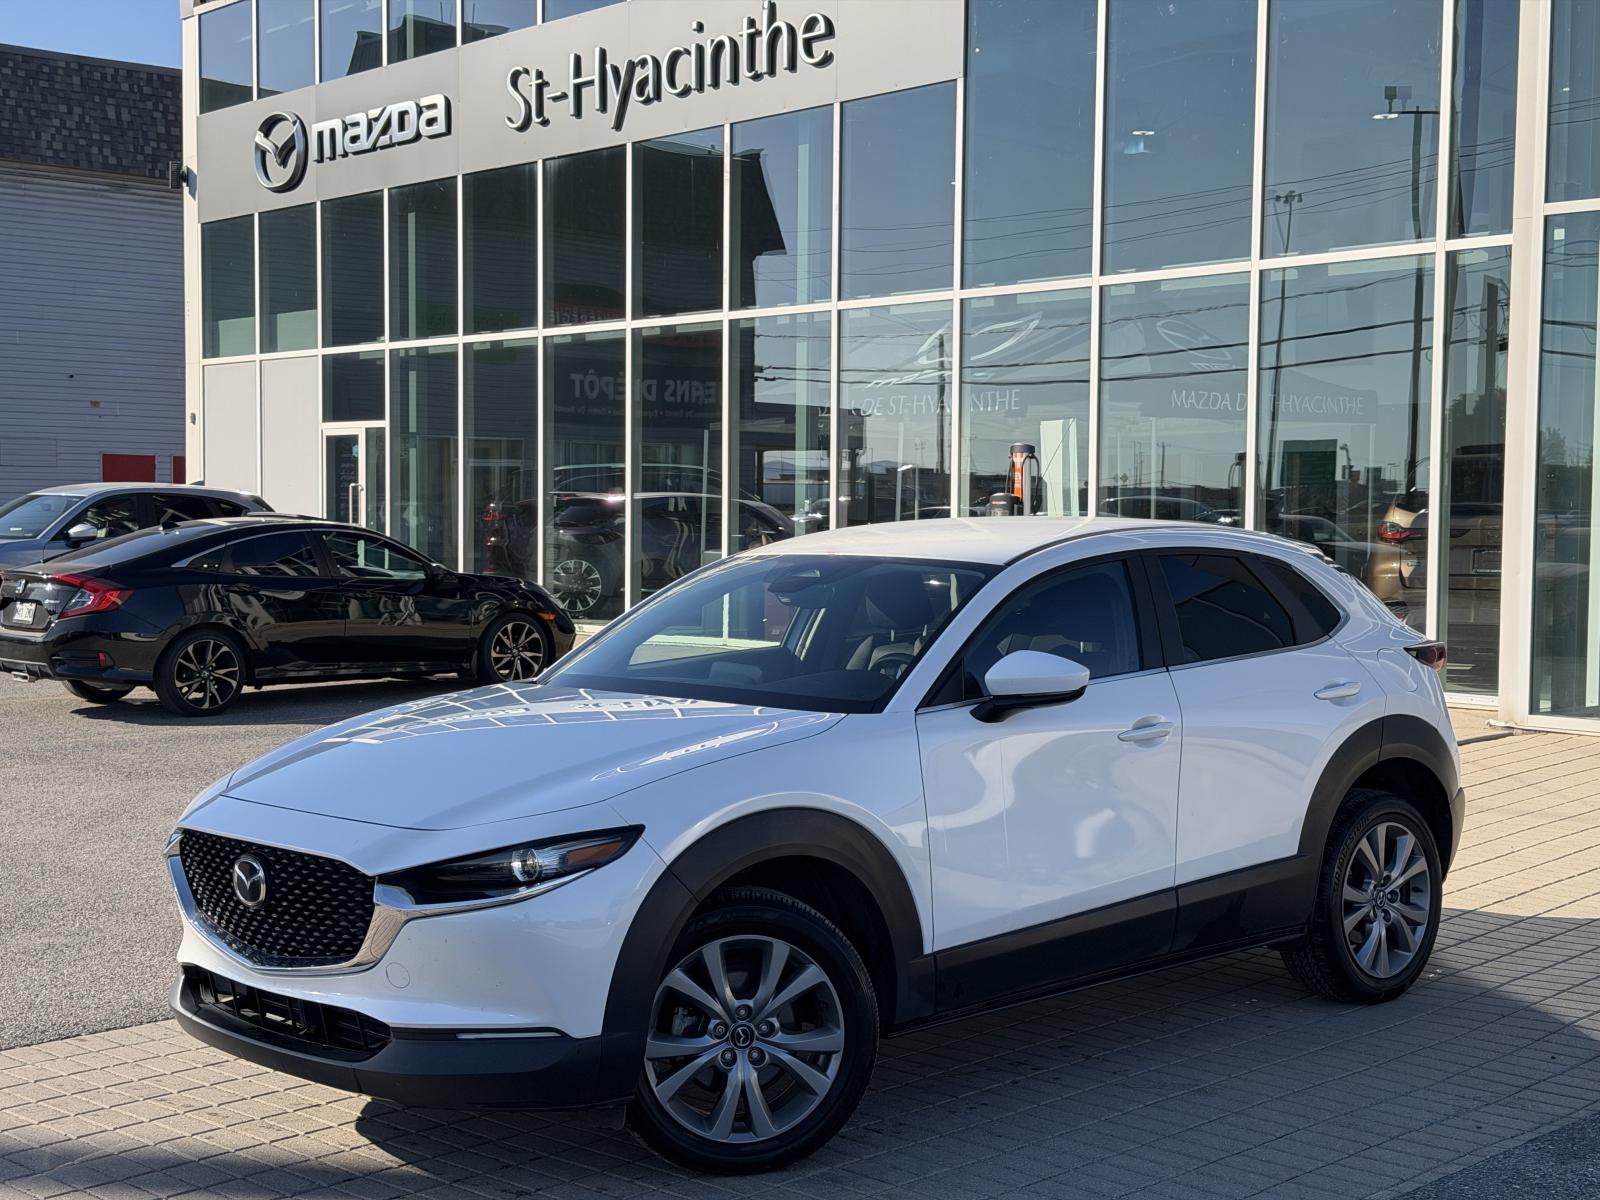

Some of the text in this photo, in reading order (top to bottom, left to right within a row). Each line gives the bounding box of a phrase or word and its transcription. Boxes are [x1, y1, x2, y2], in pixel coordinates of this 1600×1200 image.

[313, 0, 836, 163] mazda St-Hyacinthe
[887, 389, 1021, 416] ST-HYANTHE
[1171, 389, 1232, 411] MAZDA
[1267, 393, 1364, 415] T-HYACINTHE
